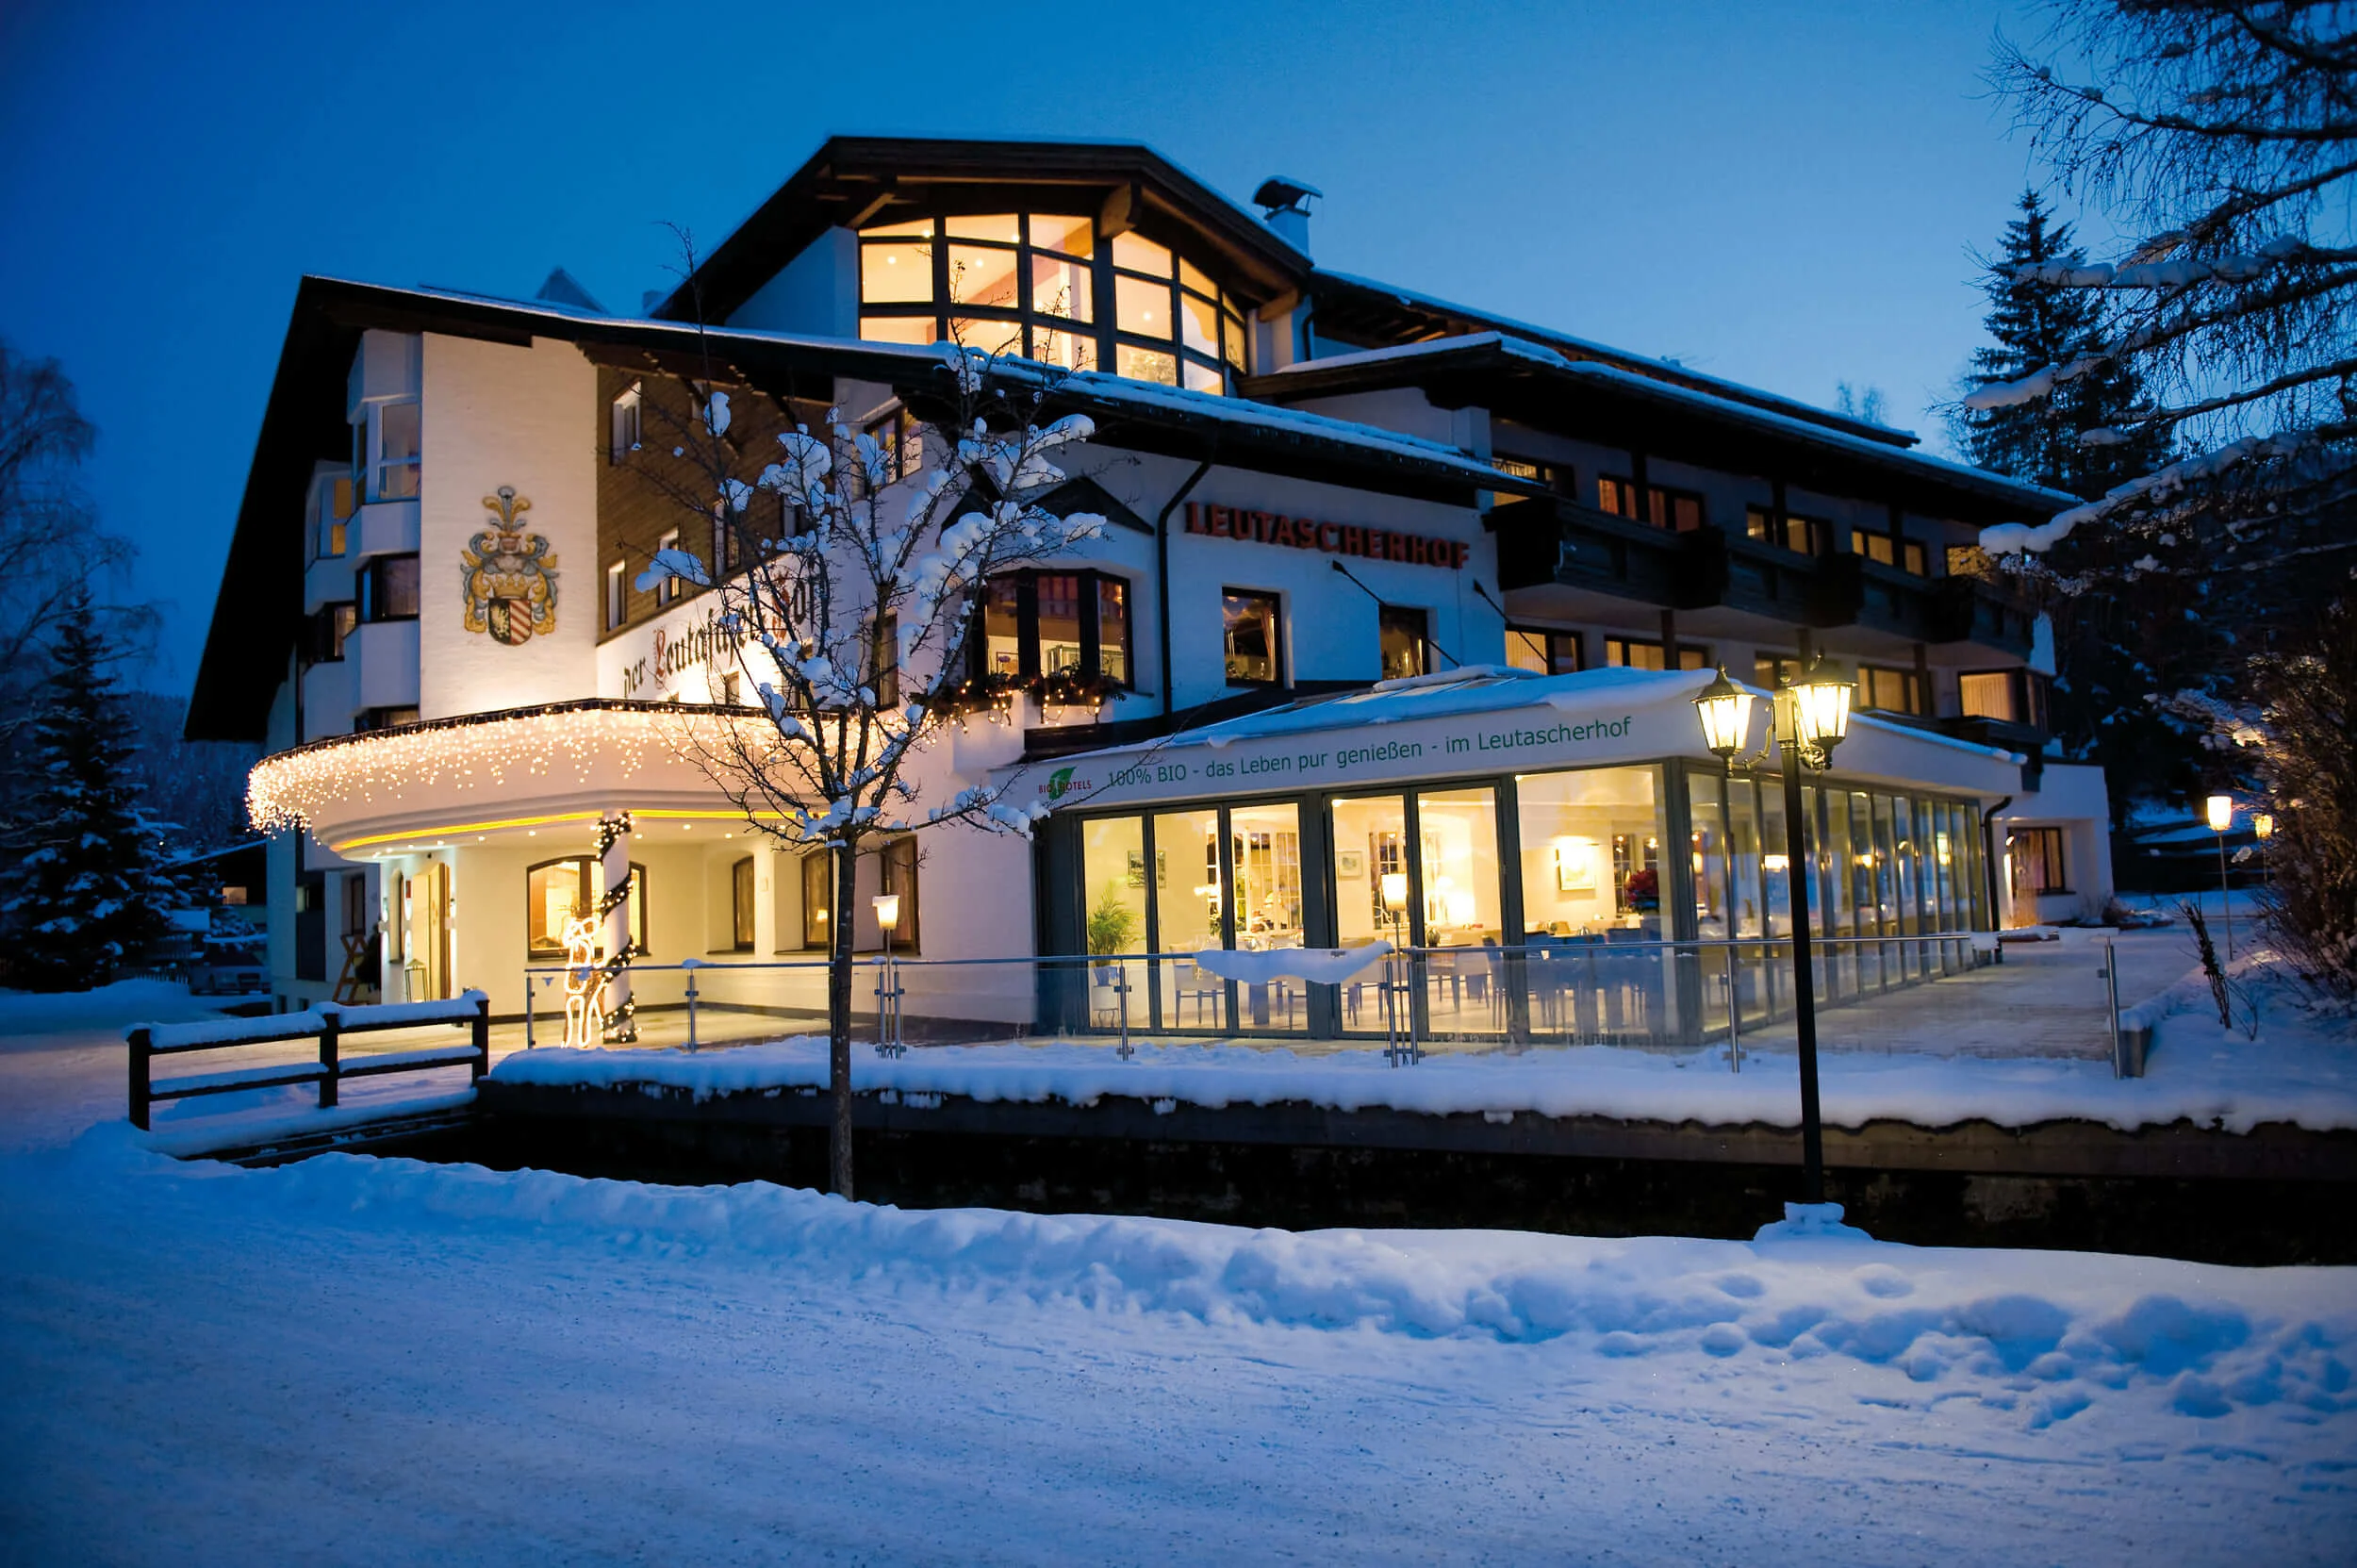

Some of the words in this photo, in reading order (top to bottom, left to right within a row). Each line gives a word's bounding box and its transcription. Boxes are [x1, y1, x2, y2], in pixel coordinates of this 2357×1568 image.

[1185, 502, 1470, 569] LEUTASCHERHOF
[1109, 767, 1152, 787] 100%
[1158, 764, 1187, 783] BIO
[1206, 756, 1234, 778] das
[1241, 753, 1292, 774] Leben
[1299, 751, 1328, 772] pur
[1337, 740, 1423, 768] genießen
[1446, 735, 1470, 754] im
[1478, 716, 1632, 751] Leutascherhof
[1038, 784, 1053, 795] BIO
[1060, 779, 1093, 794] HOTELS
